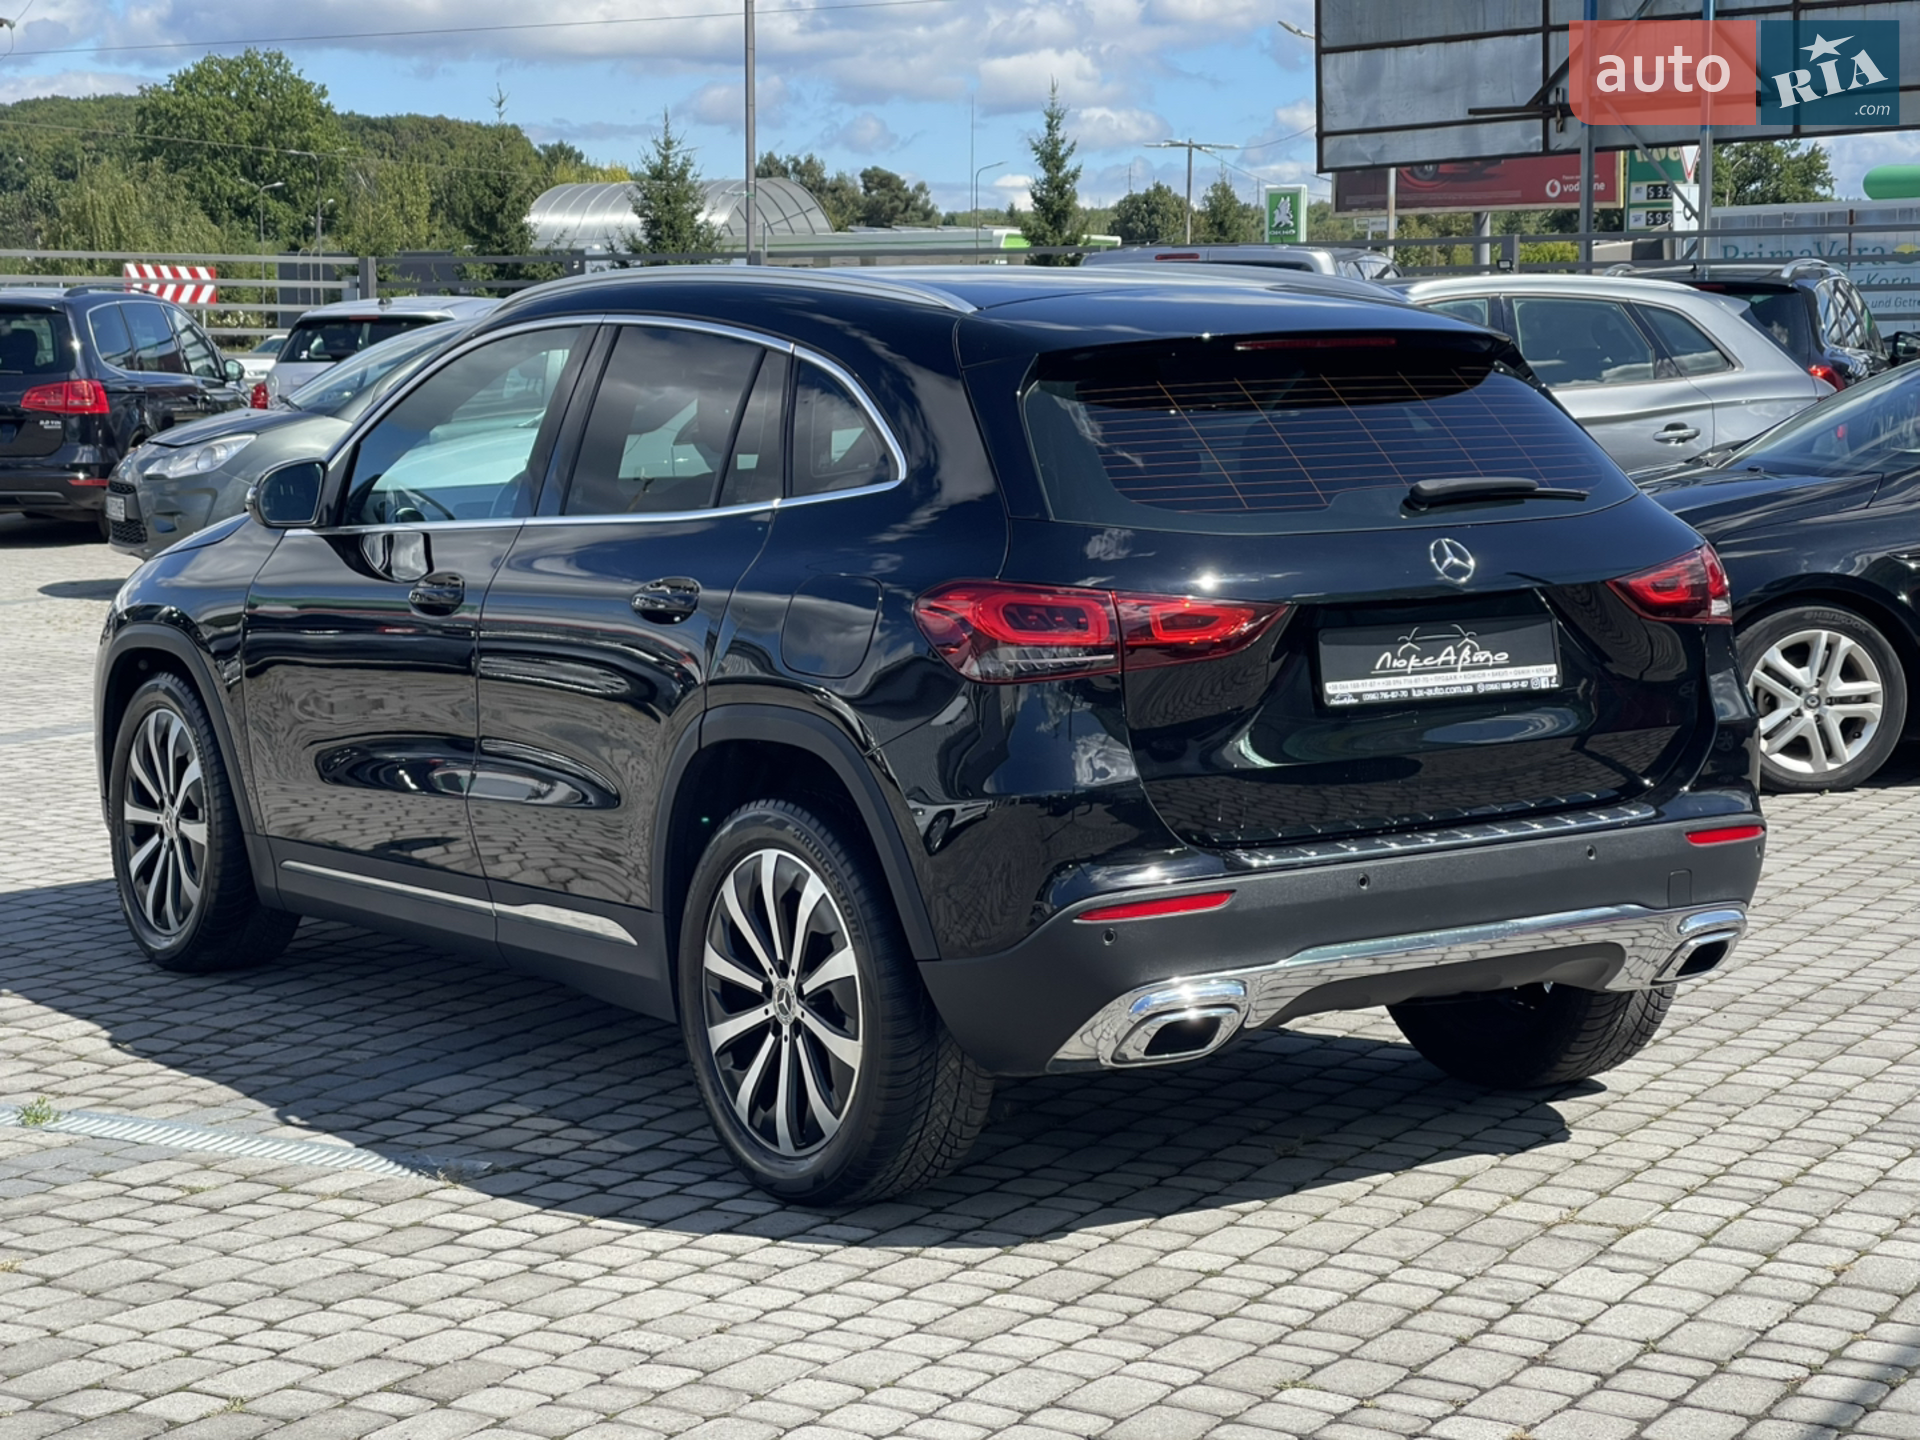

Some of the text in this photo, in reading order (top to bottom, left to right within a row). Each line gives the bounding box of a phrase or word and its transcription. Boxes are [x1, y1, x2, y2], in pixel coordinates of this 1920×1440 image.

[1562, 181, 1606, 193] vodne
[1856, 272, 1912, 285] rKorn
[1871, 297, 1892, 309] und
[1411, 683, 1473, 697] lux-auto.com.ua
[792, 828, 866, 947] BRIDGESTONE
